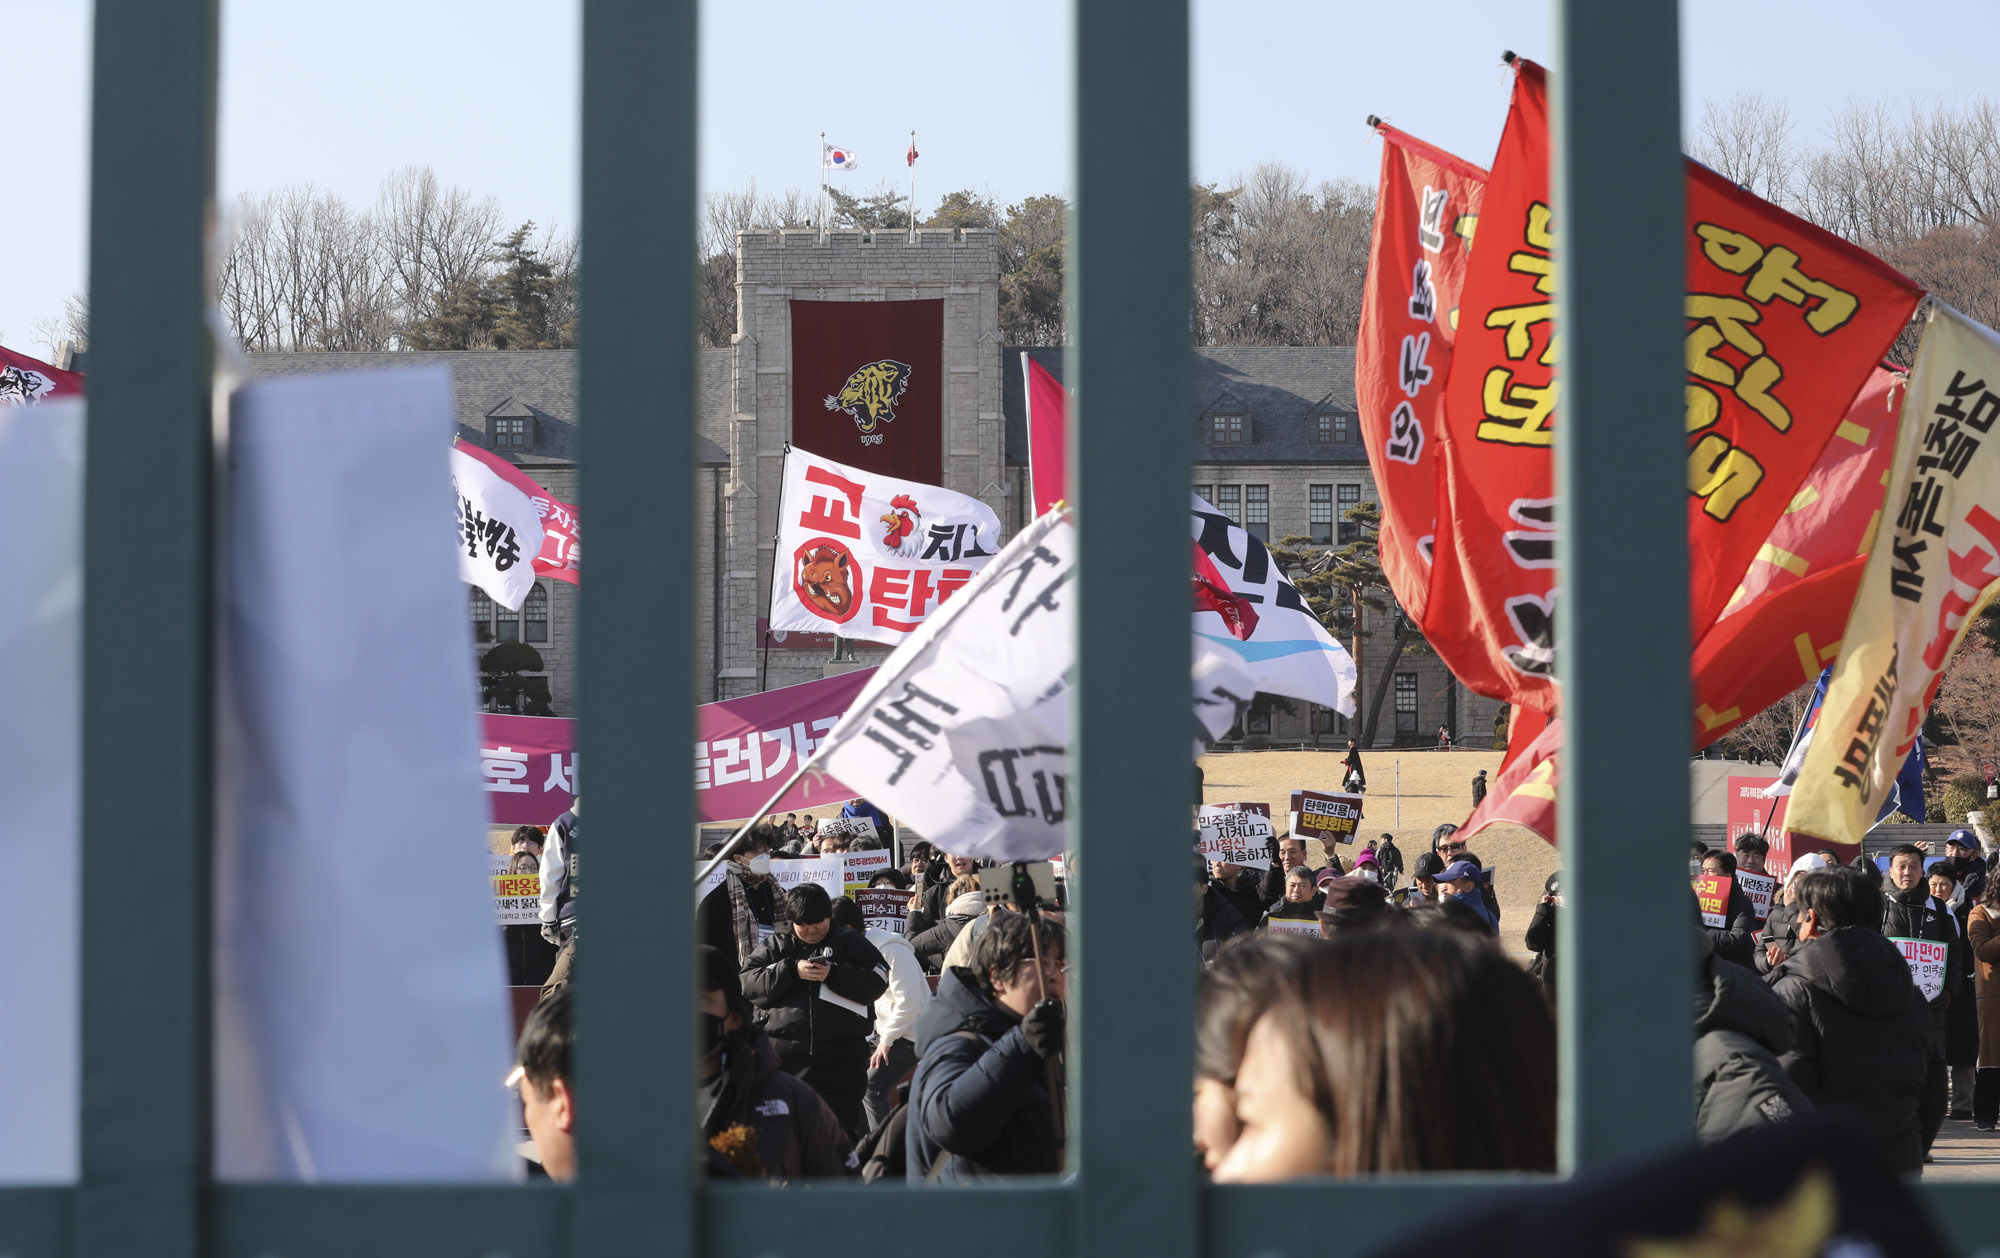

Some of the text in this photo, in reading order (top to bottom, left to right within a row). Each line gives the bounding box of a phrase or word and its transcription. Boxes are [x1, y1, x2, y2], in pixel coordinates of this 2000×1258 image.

[860, 434, 883, 446] 1905
[1198, 812, 1249, 828] 민주광장
[1302, 813, 1354, 833] 민생회복
[1218, 823, 1269, 839] 지켜내고
[1221, 847, 1273, 863] 계승하자
[1904, 941, 1945, 963] 파면이
